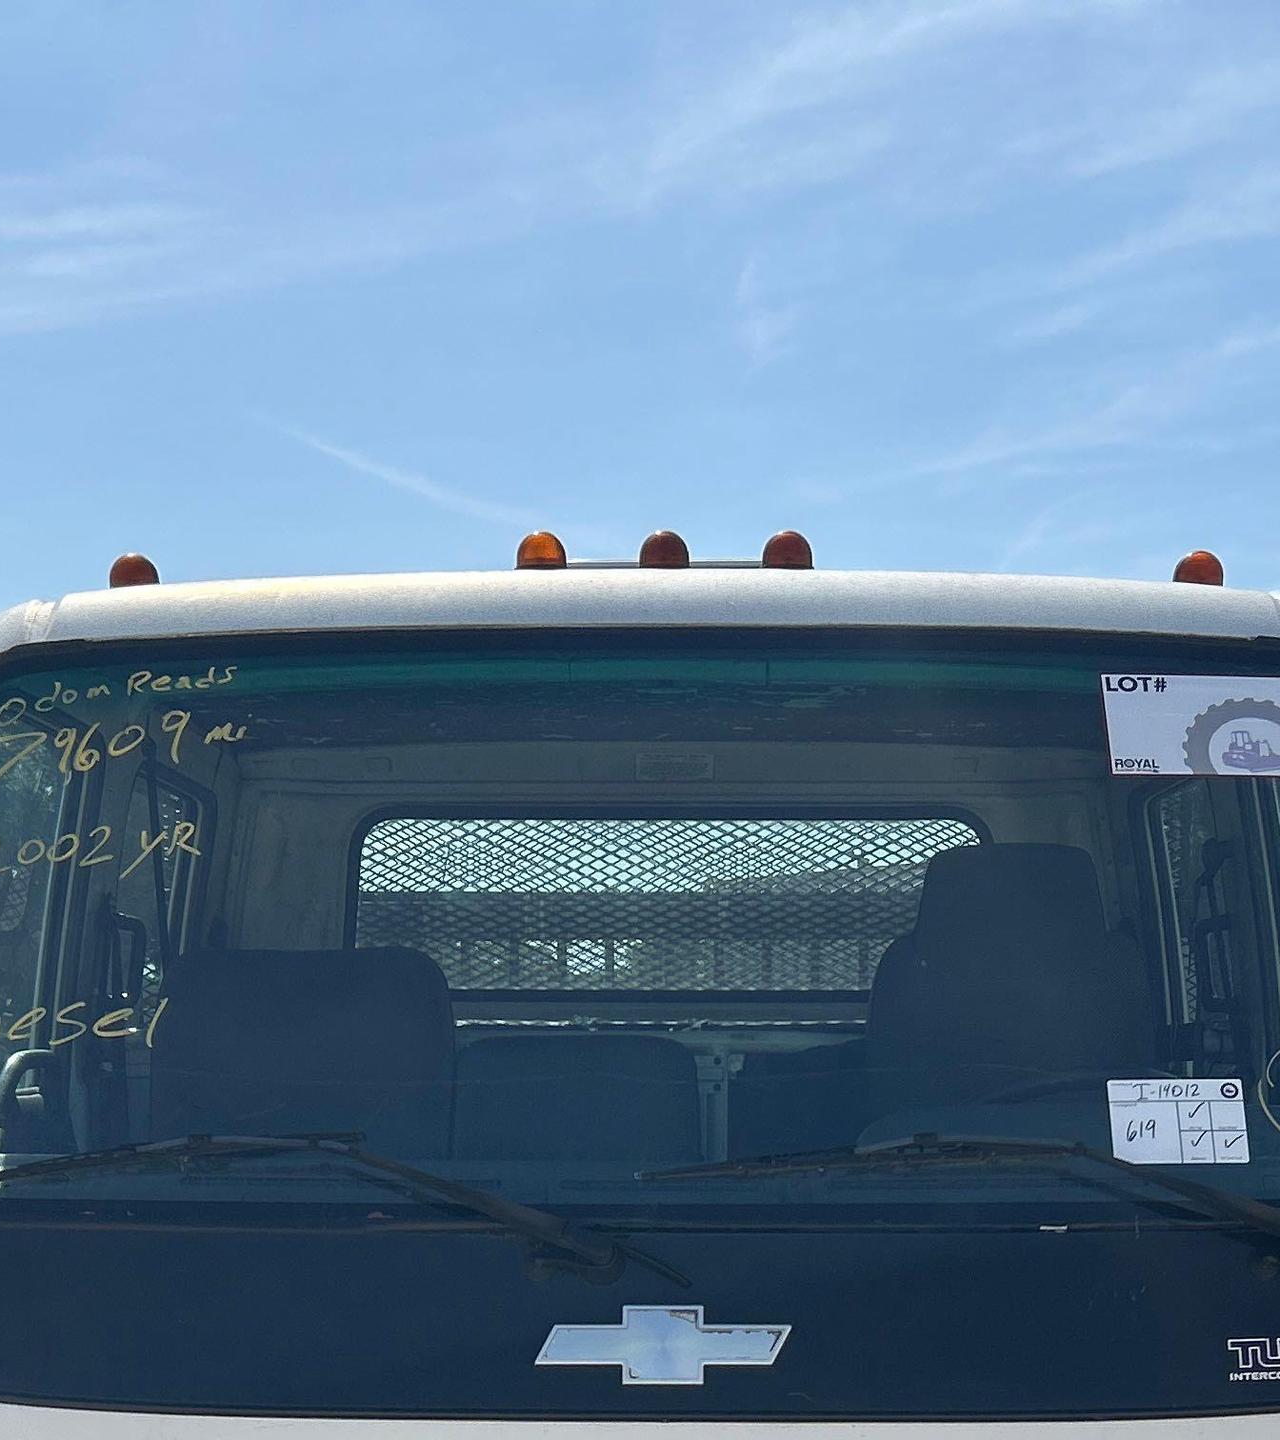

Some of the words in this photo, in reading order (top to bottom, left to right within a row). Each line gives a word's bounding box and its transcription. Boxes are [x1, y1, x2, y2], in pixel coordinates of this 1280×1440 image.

[1105, 676, 1167, 693] LOT#
[1114, 758, 1160, 769] ROYAL
[1133, 1083, 1200, 1100] I-14012
[1126, 1119, 1157, 1142] 619
